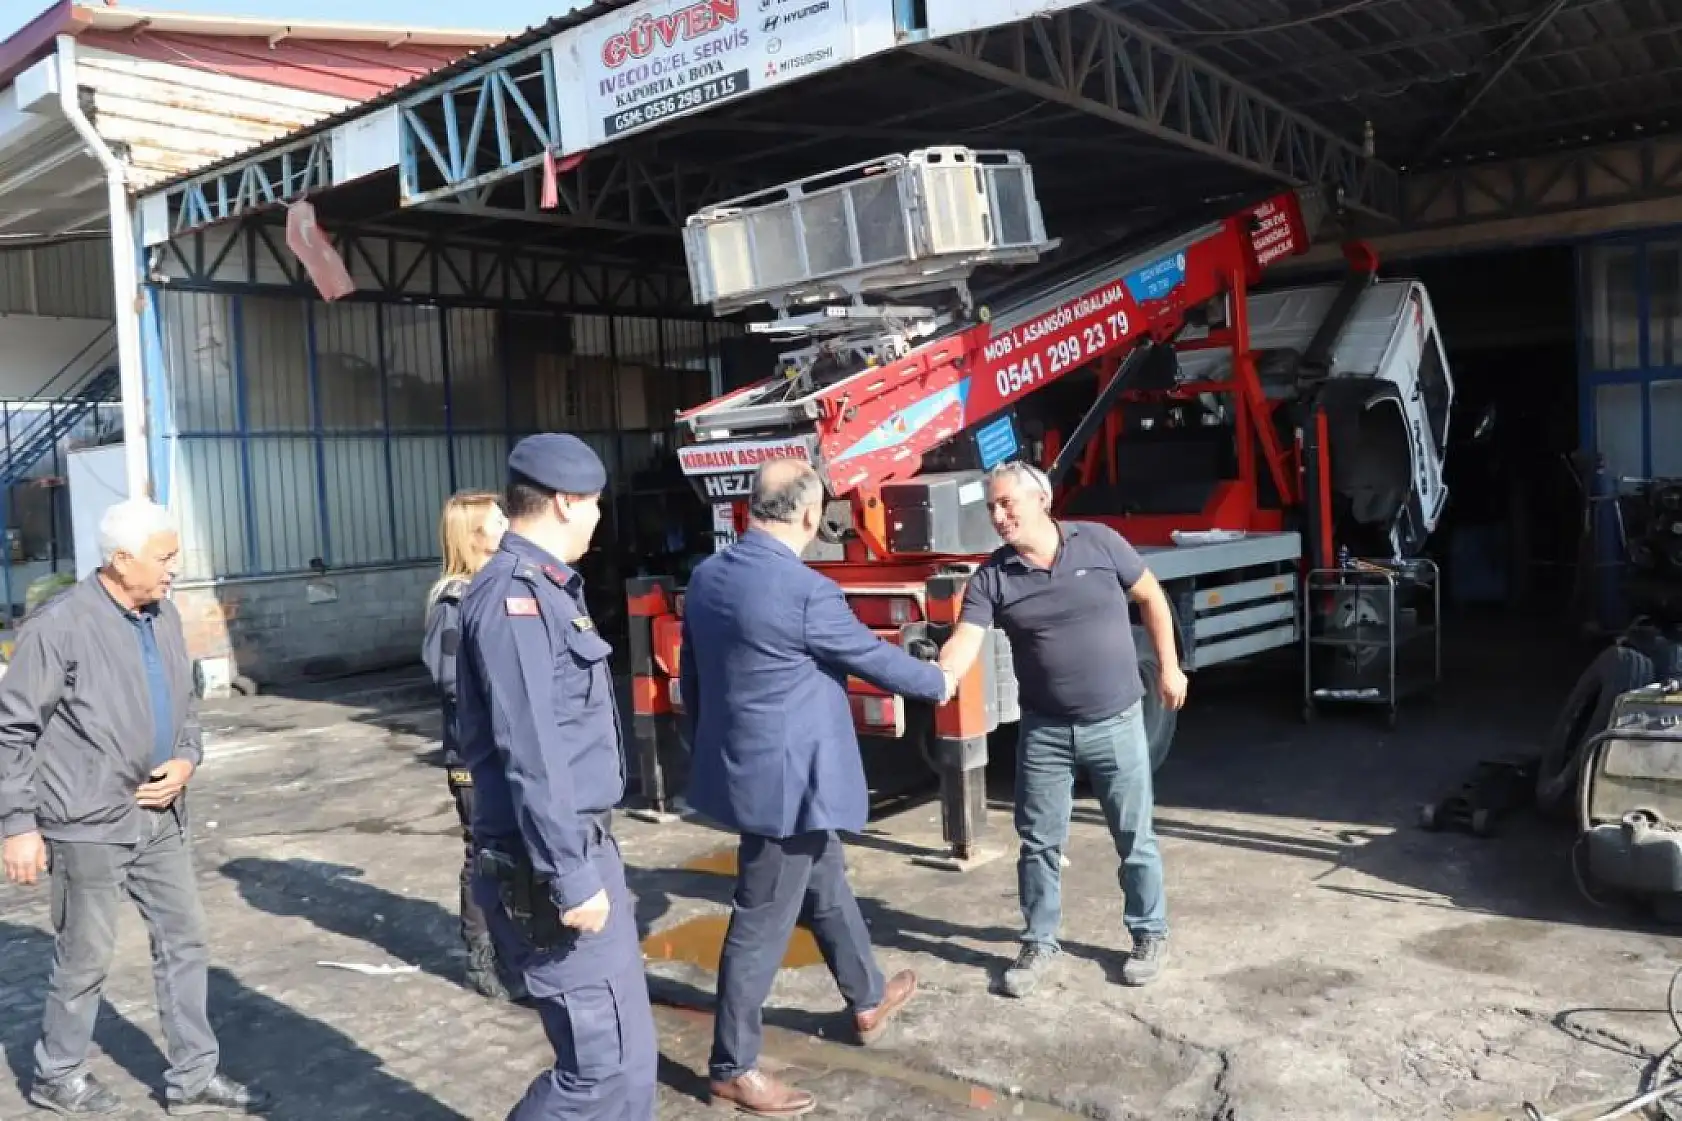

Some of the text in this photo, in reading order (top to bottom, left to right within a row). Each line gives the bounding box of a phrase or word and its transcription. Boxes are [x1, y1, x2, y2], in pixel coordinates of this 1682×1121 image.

[602, 0, 739, 68] GÜVEN
[784, 1, 829, 23] HYUNDAI
[600, 28, 749, 96] IVECO ÖZEL SERVİS
[615, 77, 675, 108] KAPORTA
[689, 59, 724, 82] BOYA
[779, 46, 832, 72] MITSUBISHI
[644, 97, 676, 120] 0536
[1022, 305, 1073, 345] ASANSÖR
[1073, 284, 1124, 321] KİRALAMA
[996, 309, 1129, 398] 0541 299 23 79
[738, 443, 808, 464] ASANSÖR
